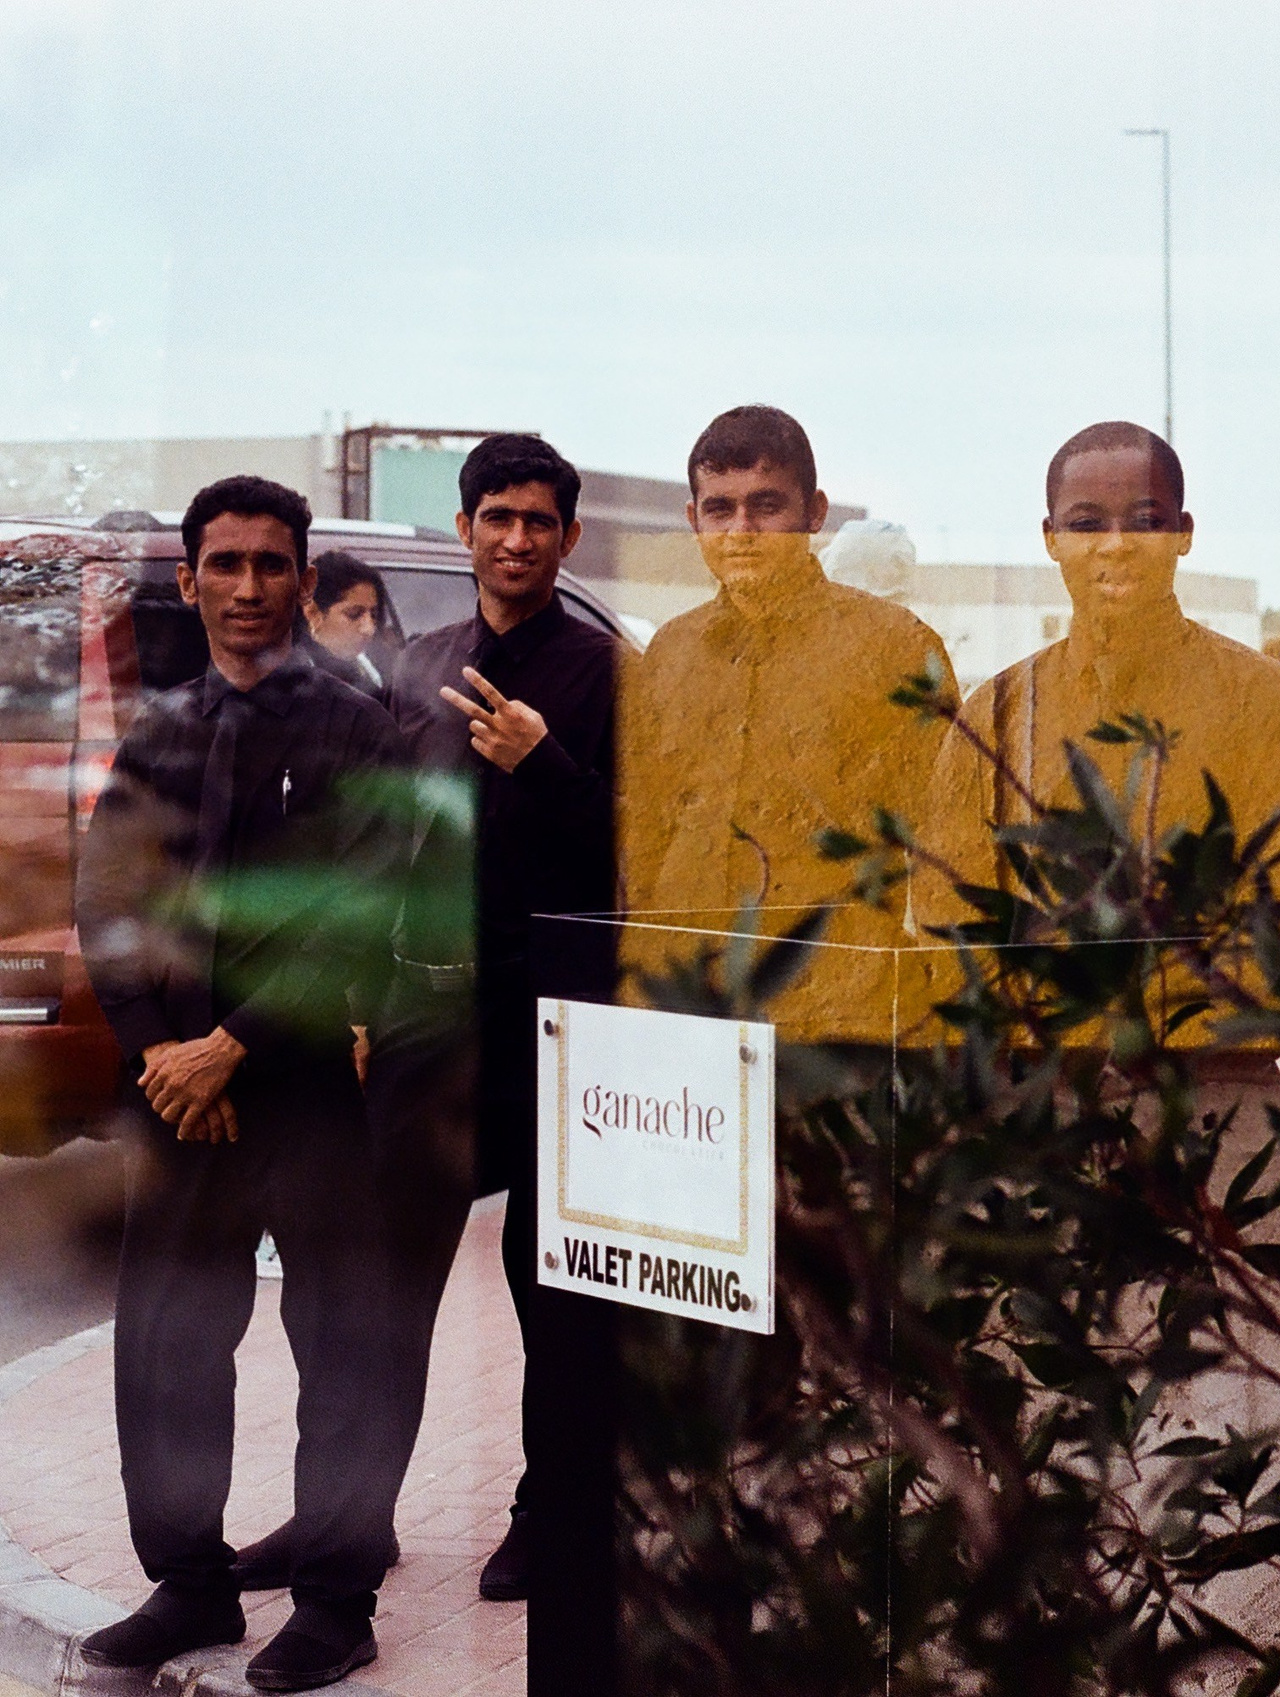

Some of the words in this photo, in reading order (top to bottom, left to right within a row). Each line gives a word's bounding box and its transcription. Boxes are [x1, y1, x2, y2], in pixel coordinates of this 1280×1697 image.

[582, 1084, 726, 1145] ganache
[563, 1236, 633, 1288] VALET
[638, 1252, 742, 1313] PARKING
